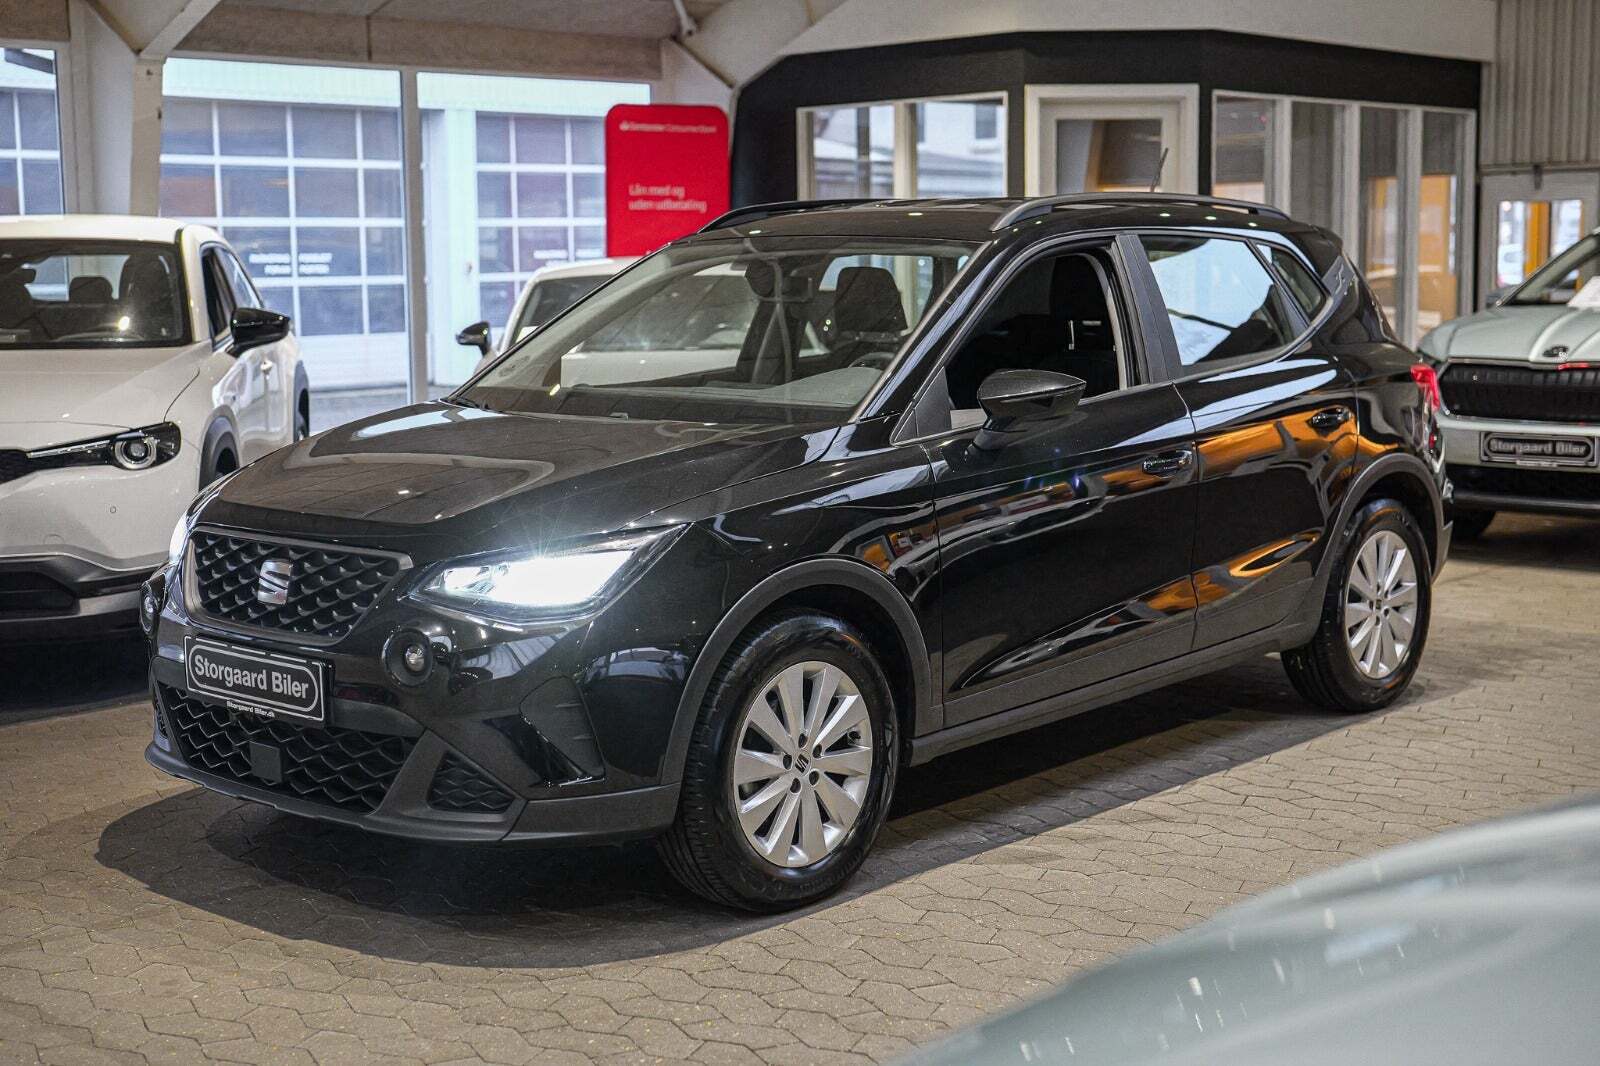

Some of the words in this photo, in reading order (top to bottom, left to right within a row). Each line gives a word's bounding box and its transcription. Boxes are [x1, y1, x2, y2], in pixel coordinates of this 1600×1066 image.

[194, 654, 268, 691] Storgaard
[271, 671, 309, 699] Biler
[226, 700, 254, 713] Storgaard
